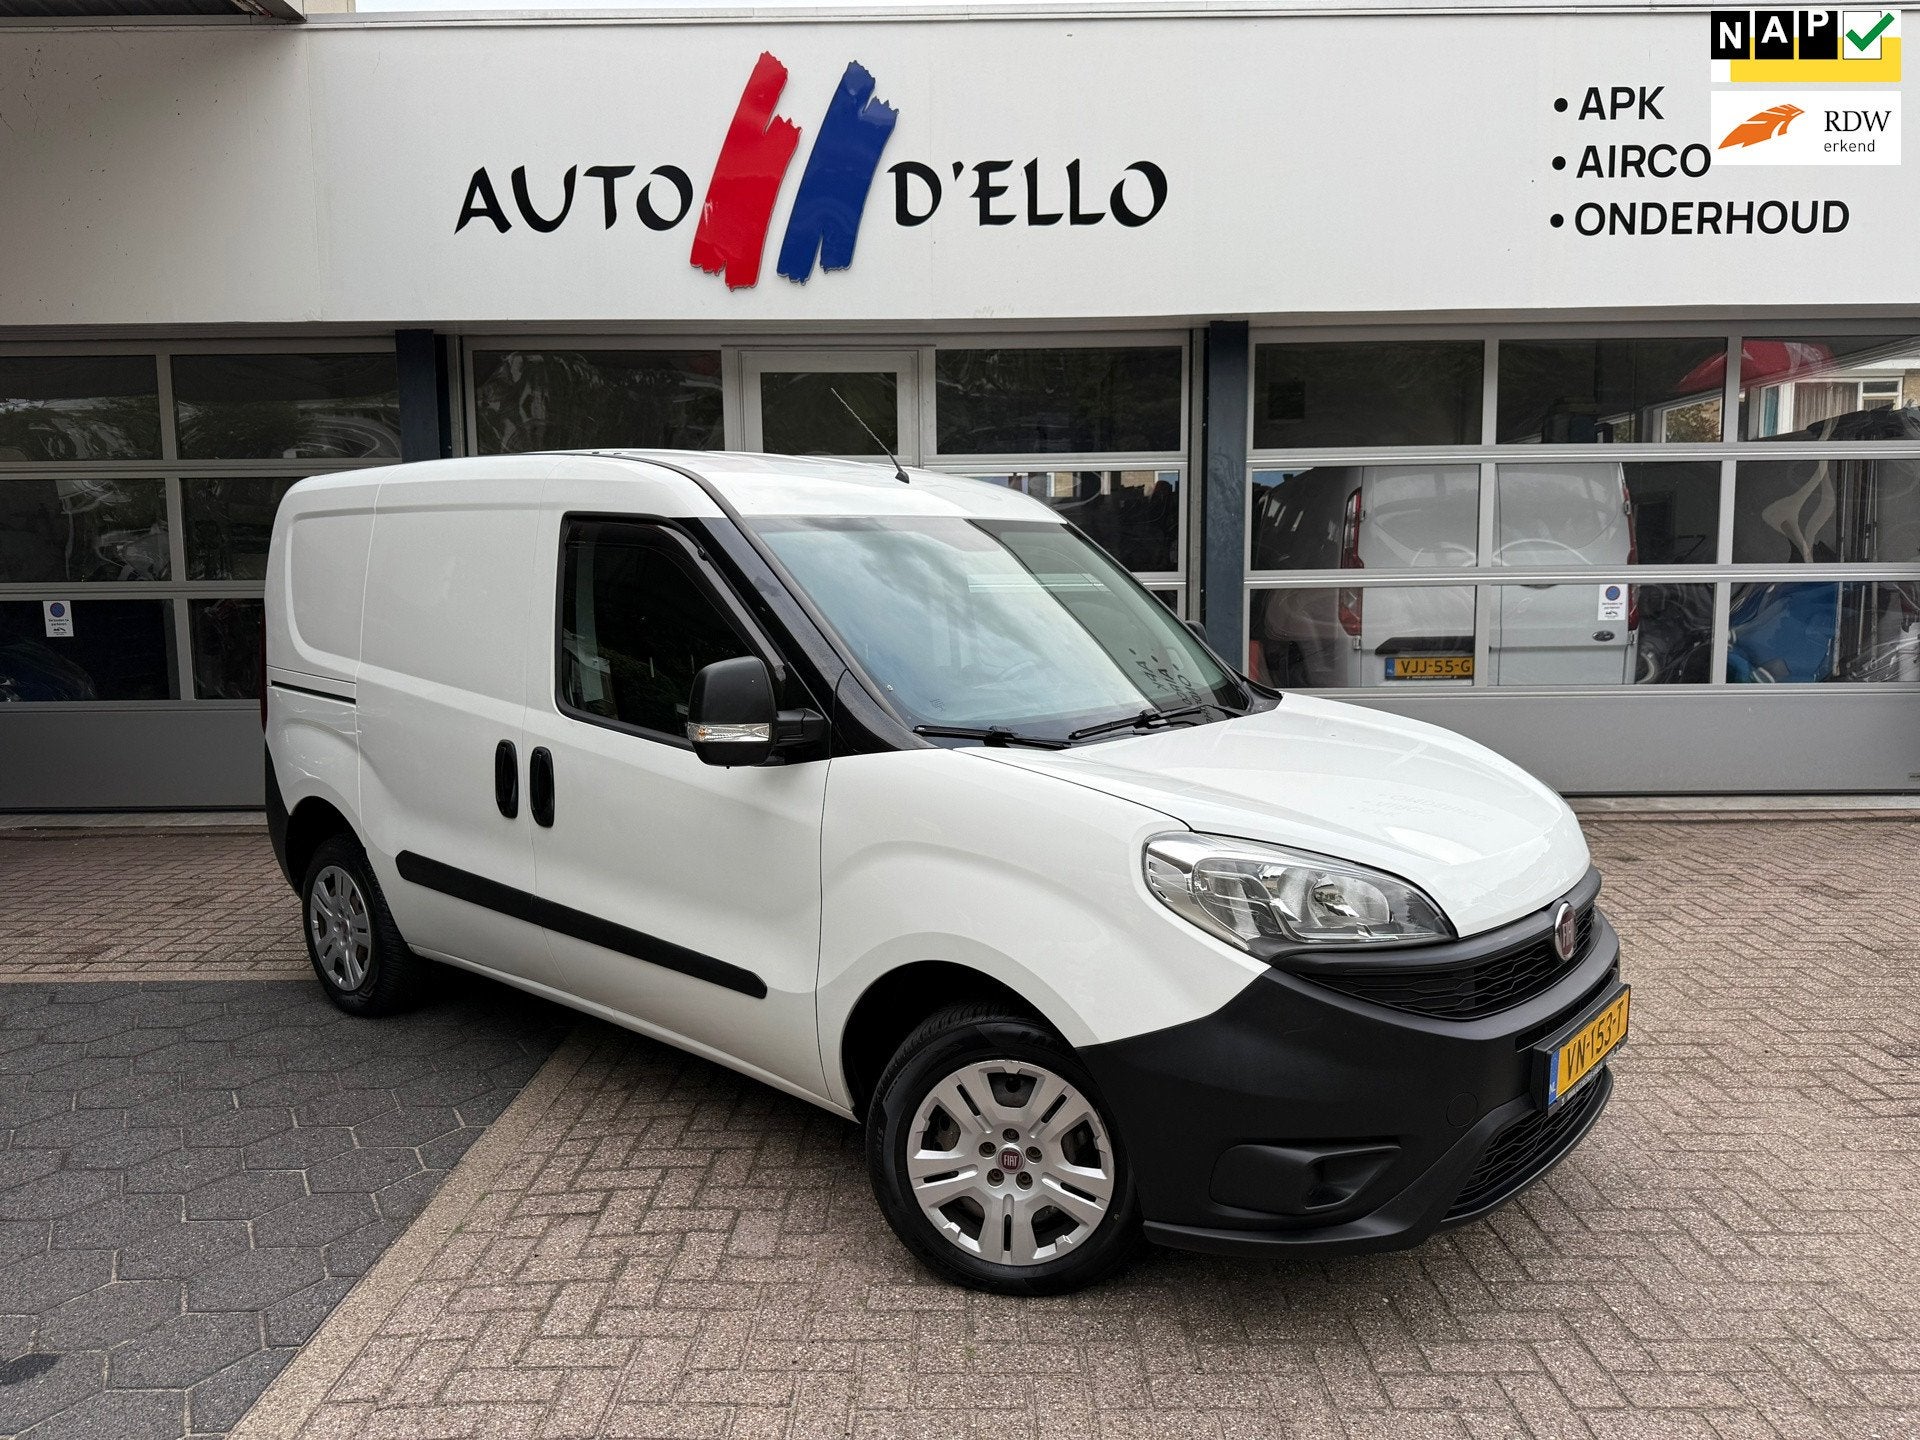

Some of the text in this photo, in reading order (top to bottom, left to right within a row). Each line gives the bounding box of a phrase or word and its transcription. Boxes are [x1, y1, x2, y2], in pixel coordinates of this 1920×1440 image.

[1578, 86, 1665, 121] APK
[1576, 143, 1711, 179] AIRCO
[454, 159, 1169, 235] AUTO D'ELLO
[1574, 200, 1850, 236] ONDERHOUD
[1401, 660, 1470, 673] VJJ-55-G
[1567, 1000, 1624, 1081] VN-153-T
[1003, 1155, 1017, 1167] FIAT
